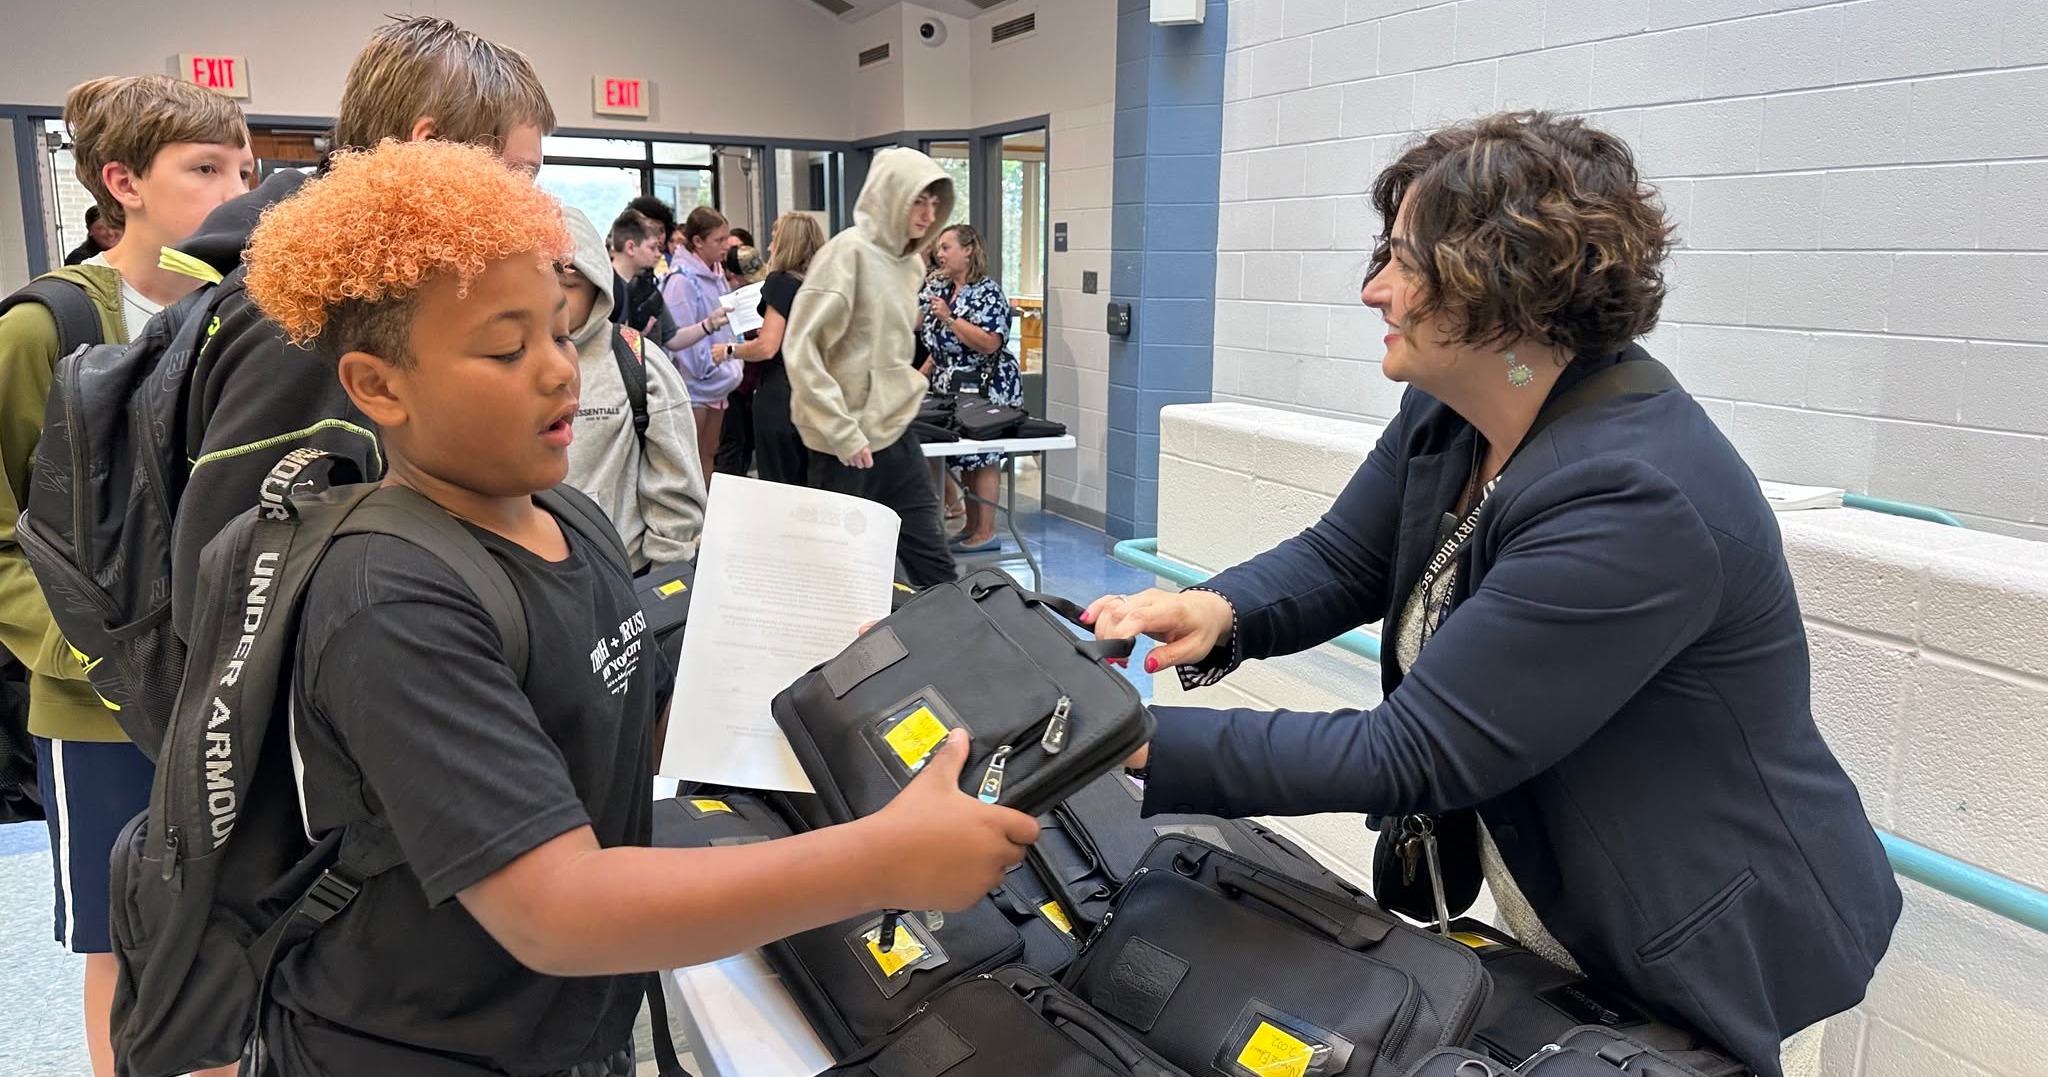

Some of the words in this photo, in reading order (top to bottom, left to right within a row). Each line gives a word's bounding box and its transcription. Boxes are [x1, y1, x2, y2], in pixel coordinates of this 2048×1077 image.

[193, 58, 234, 88] EXIT
[606, 79, 640, 108] EXIT
[1429, 538, 1459, 574] HIGH
[219, 551, 280, 688] UNDER
